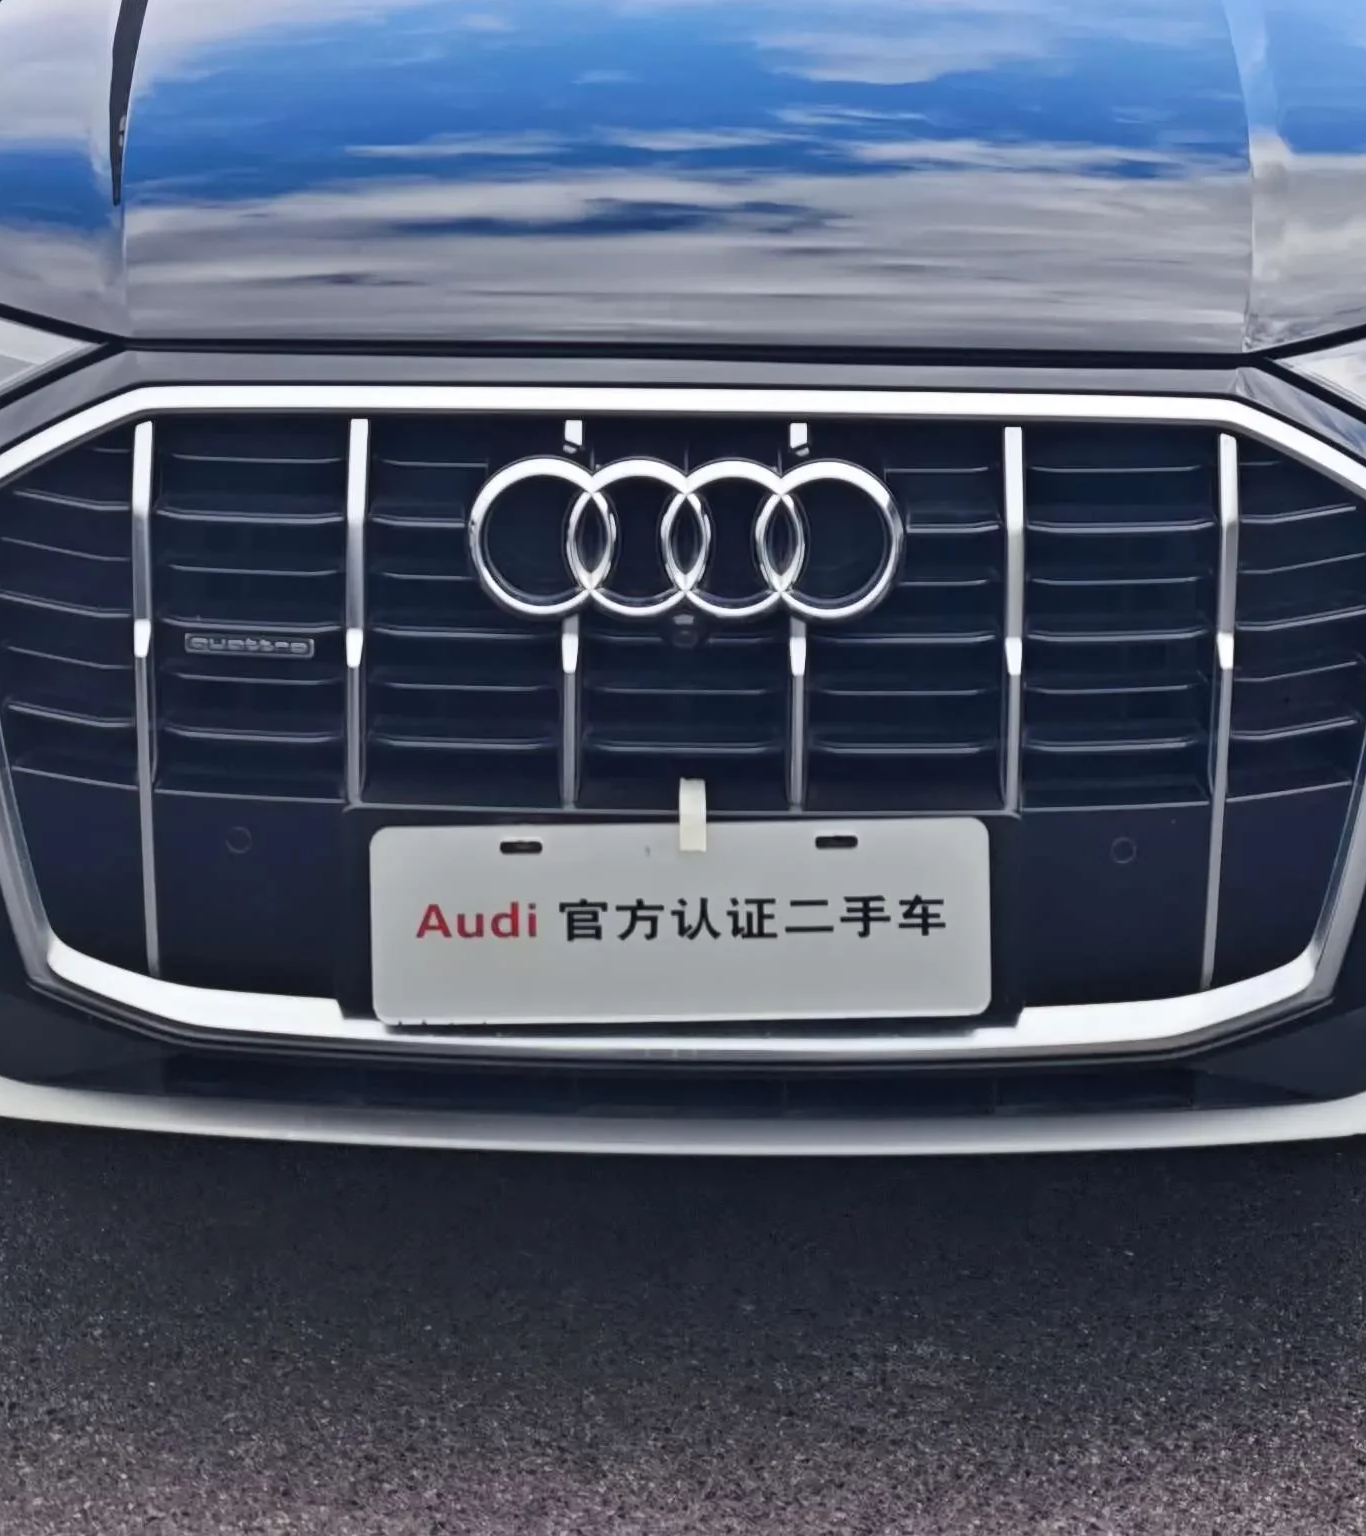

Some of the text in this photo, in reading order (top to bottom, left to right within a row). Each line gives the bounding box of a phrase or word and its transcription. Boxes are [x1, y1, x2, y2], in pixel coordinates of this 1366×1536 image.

[190, 636, 309, 655] quattro
[416, 895, 947, 942] Audi 官方认证二手车
